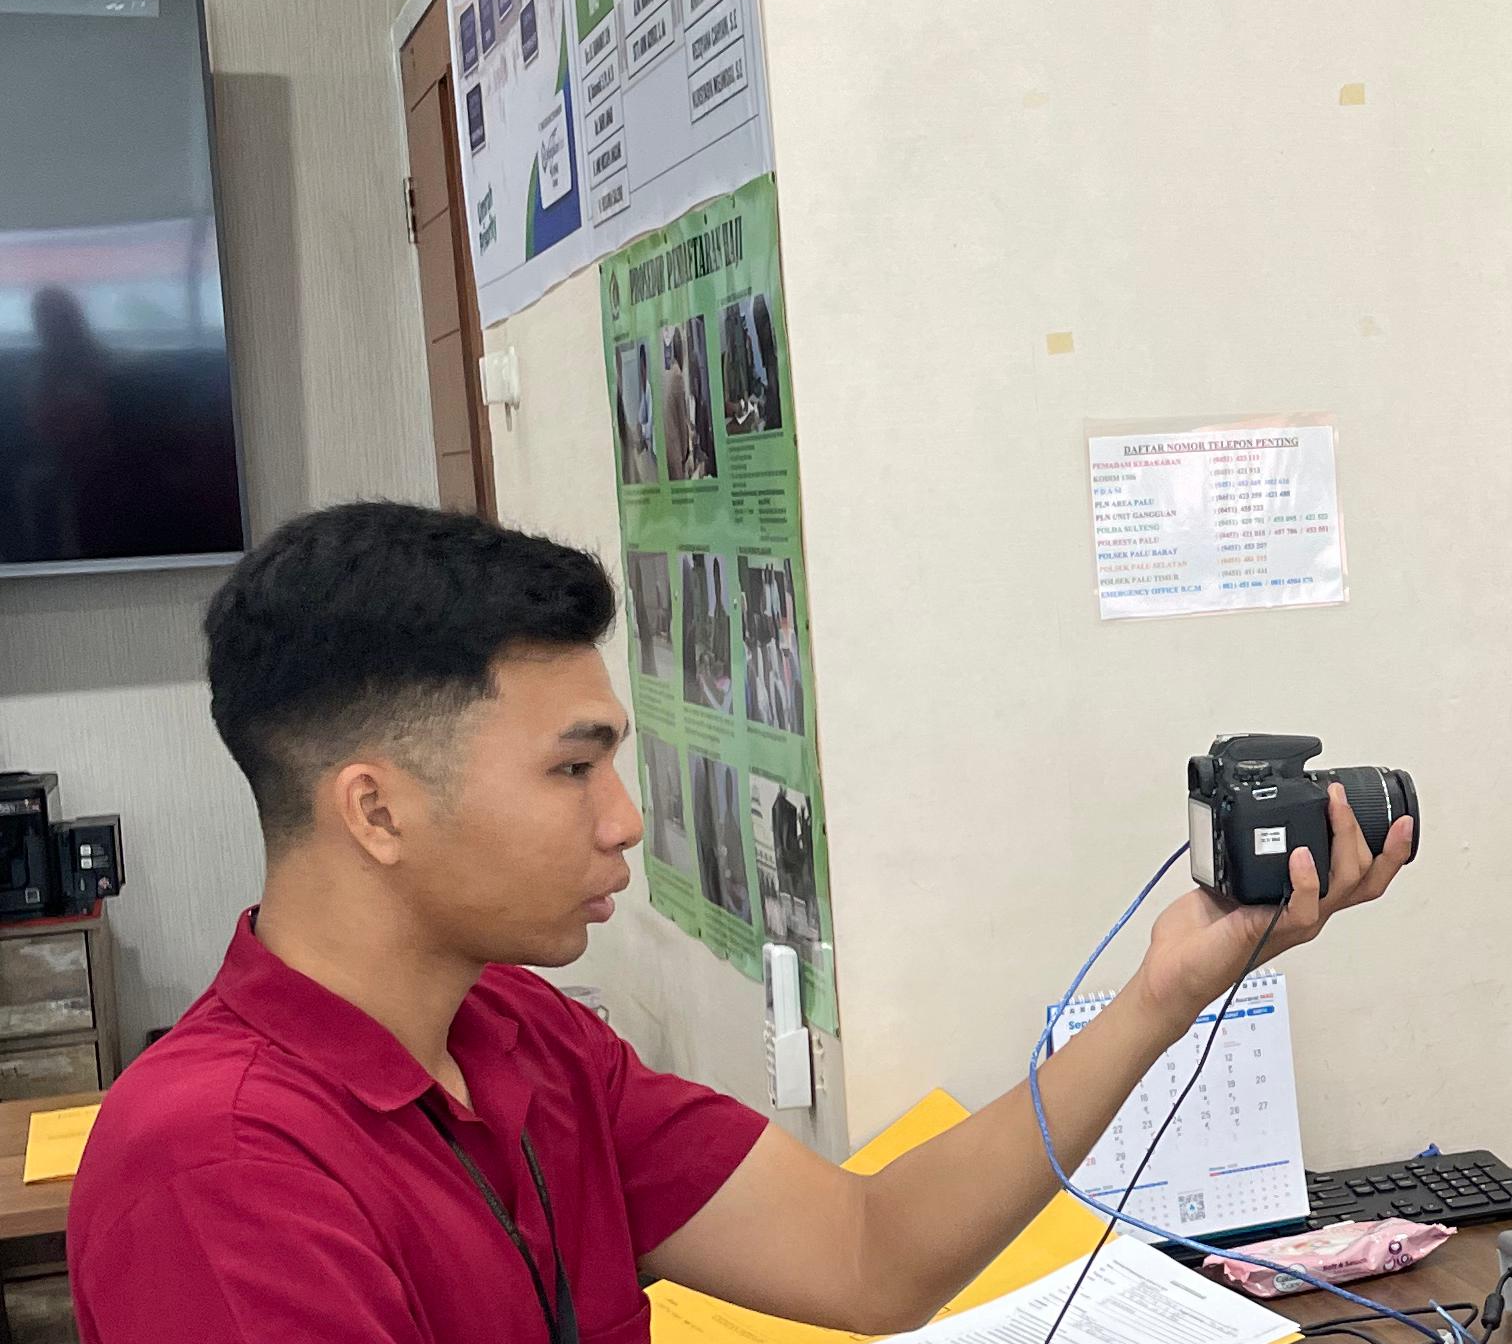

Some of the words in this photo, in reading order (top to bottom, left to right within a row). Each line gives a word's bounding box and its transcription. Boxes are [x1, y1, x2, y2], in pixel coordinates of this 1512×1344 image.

[722, 215, 743, 269] HAJI
[1124, 444, 1164, 455] DAFTAR
[1166, 441, 1205, 452] NOMOR
[1208, 439, 1253, 450] TELEPON
[1255, 437, 1299, 448] PENTING
[1133, 510, 1176, 520] GANGGUAN
